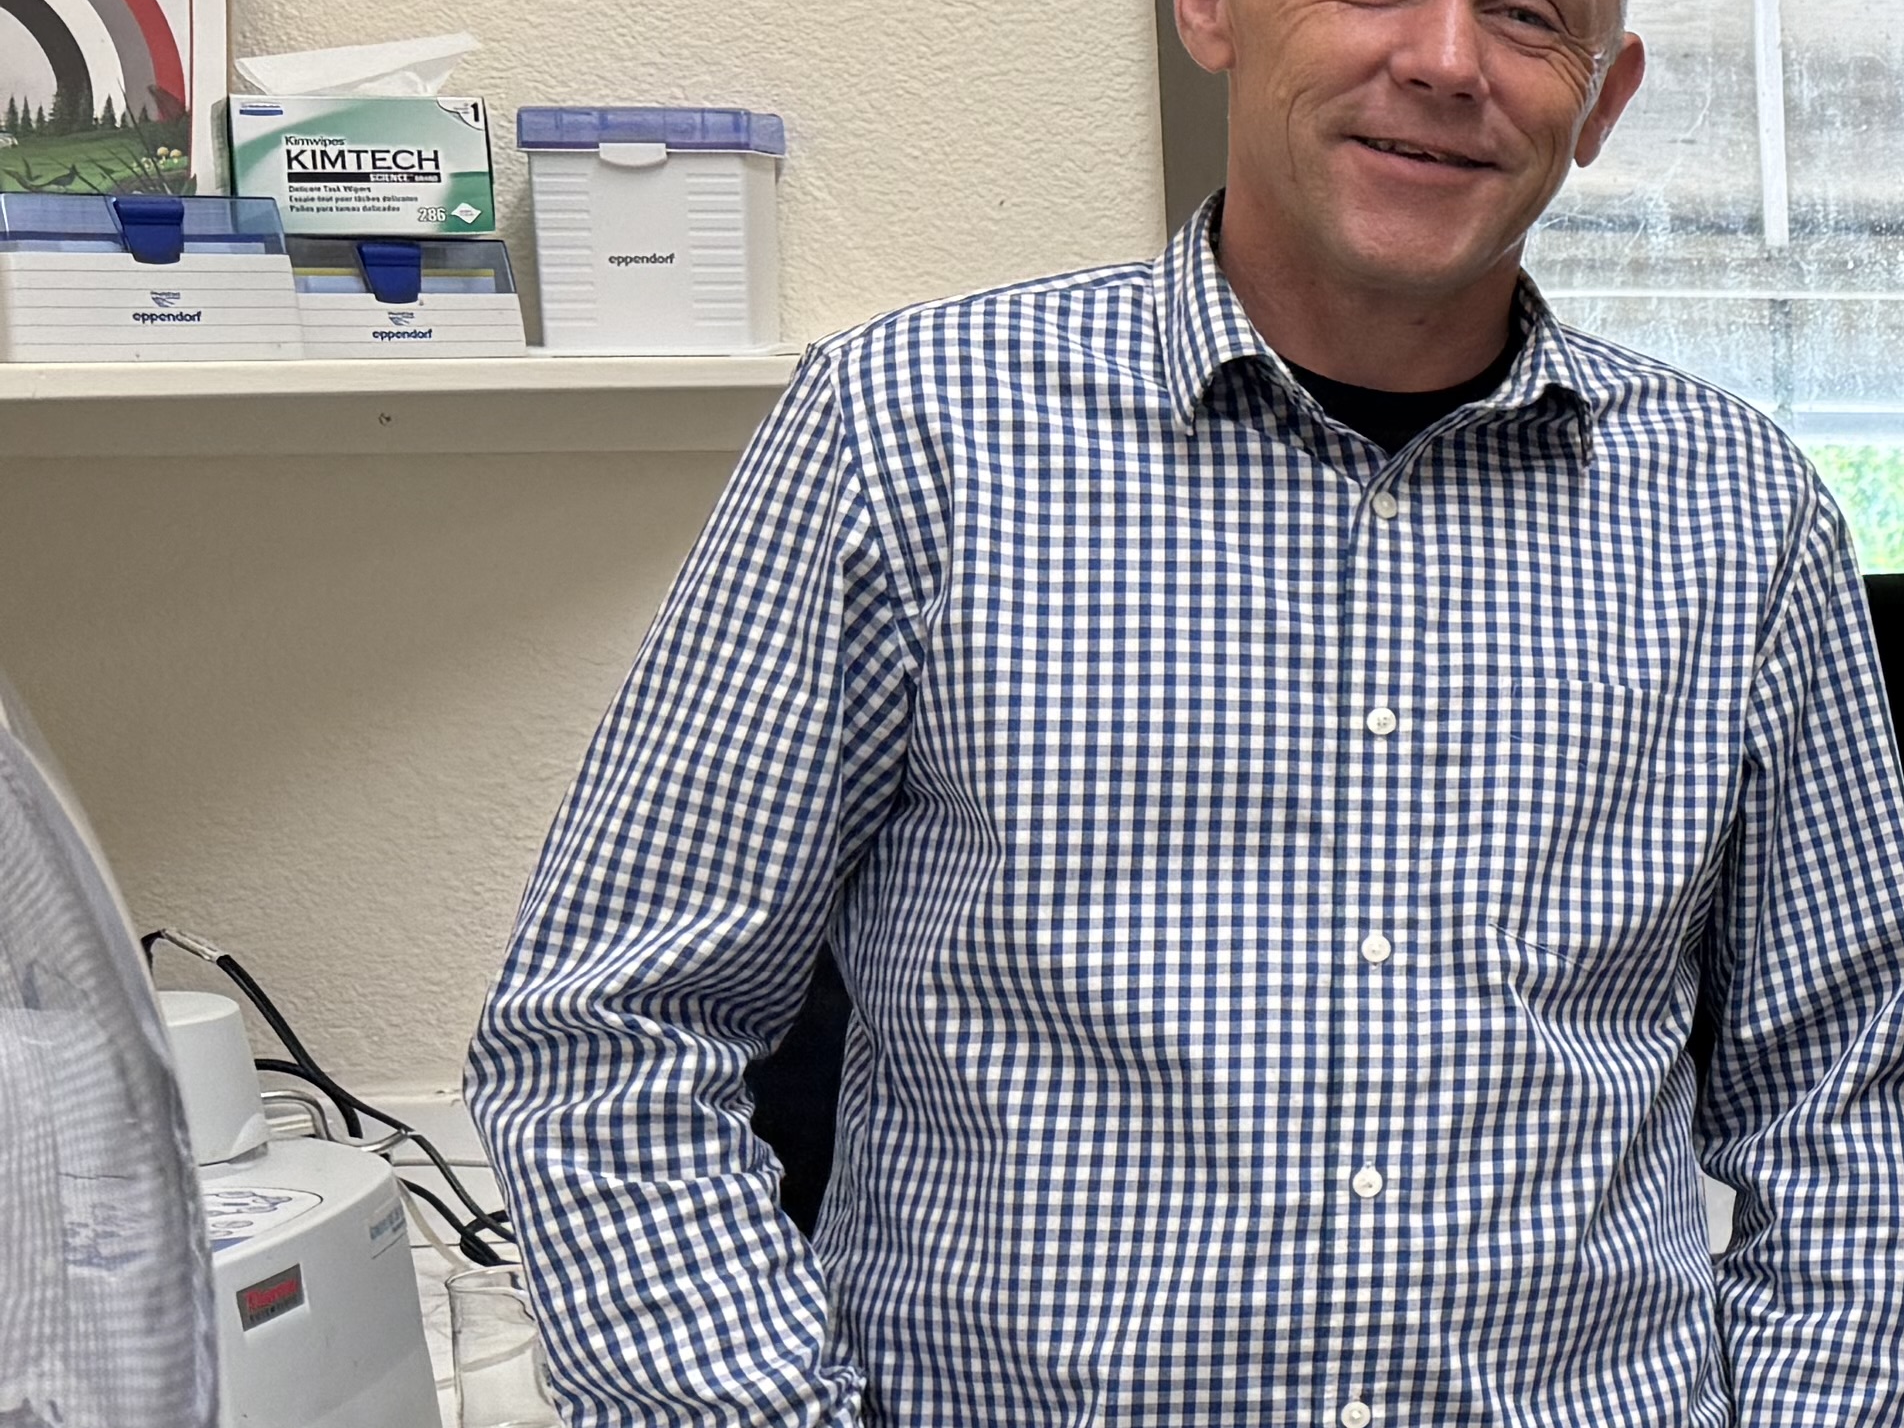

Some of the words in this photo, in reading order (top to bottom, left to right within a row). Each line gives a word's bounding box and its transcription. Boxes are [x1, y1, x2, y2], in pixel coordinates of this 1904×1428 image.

[285, 135, 345, 148] Kimwipes
[286, 149, 440, 170] KIMTECH
[418, 207, 446, 222] 286
[609, 252, 675, 267] eppendorf
[132, 310, 202, 325] eppendorf
[372, 328, 433, 341] eppendorf
